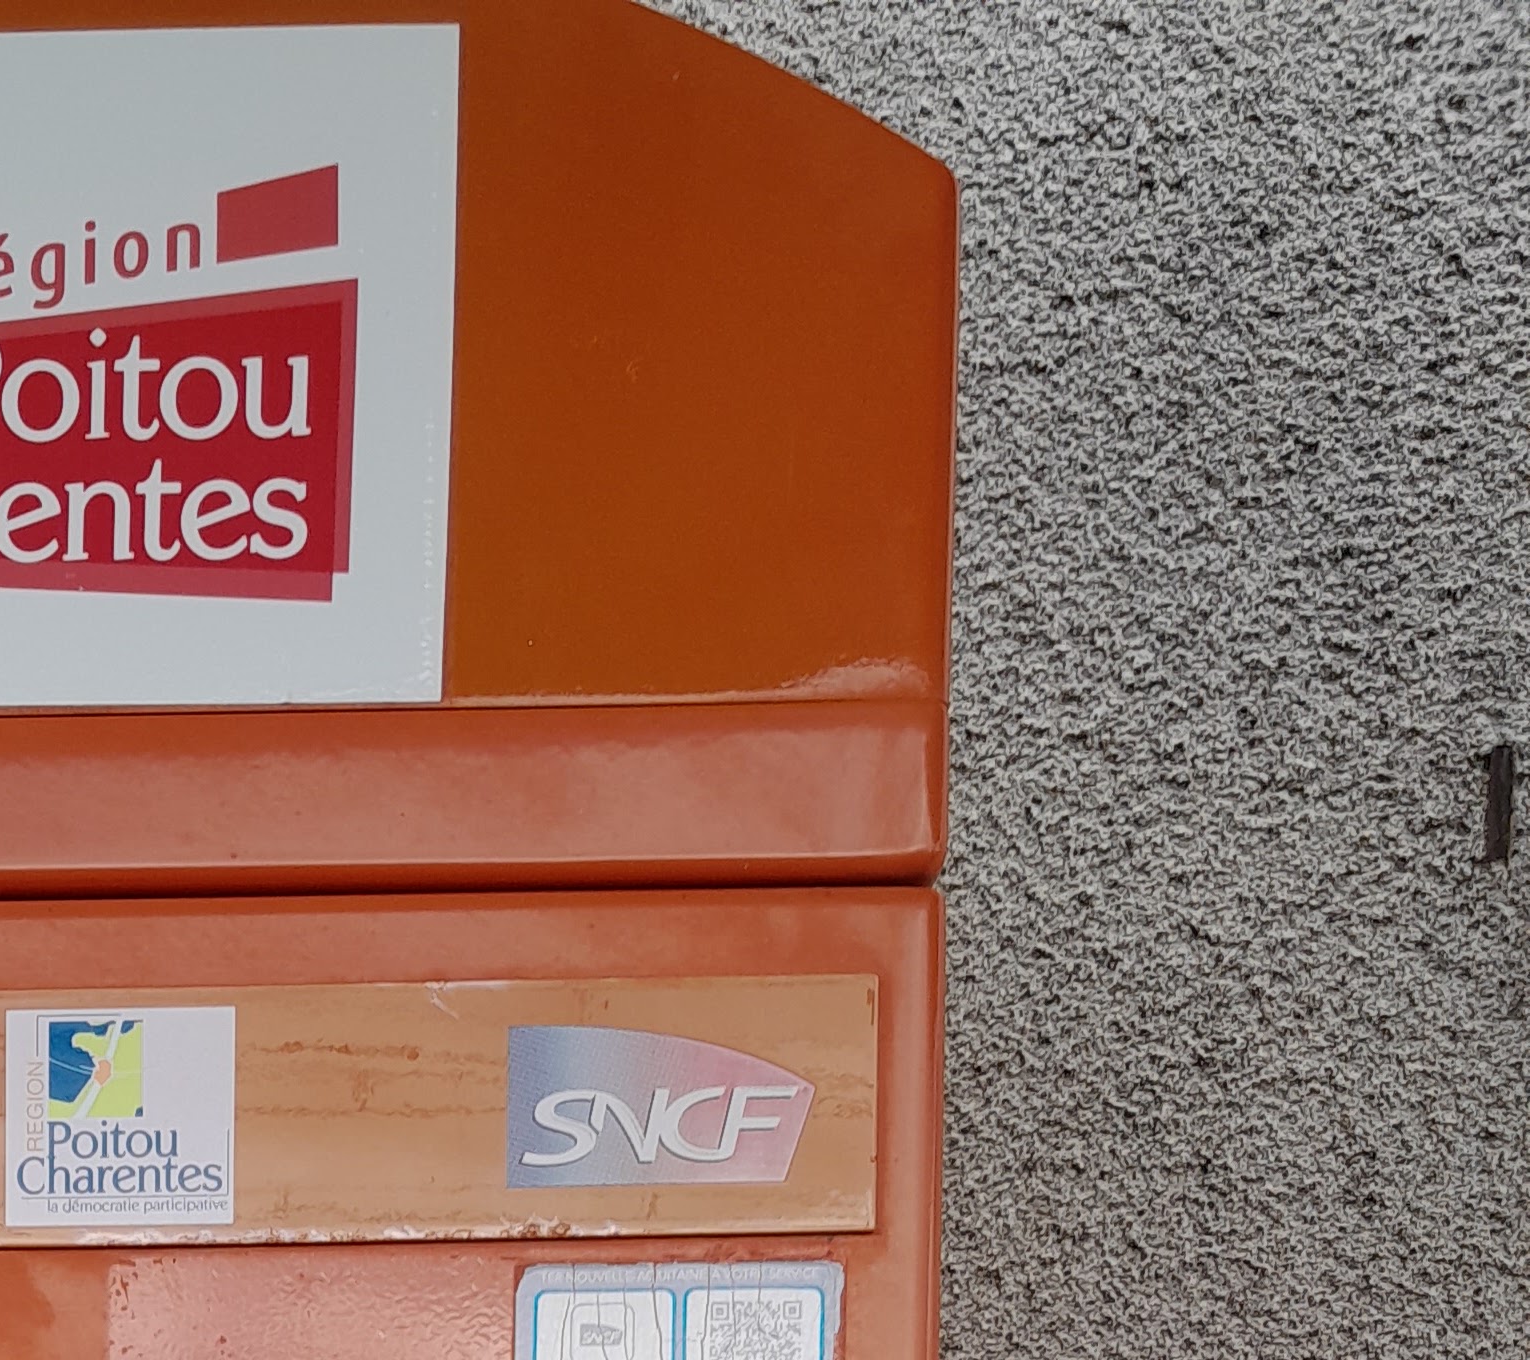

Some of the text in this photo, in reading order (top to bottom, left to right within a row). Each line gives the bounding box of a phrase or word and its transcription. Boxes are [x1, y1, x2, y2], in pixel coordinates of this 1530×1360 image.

[27, 1061, 45, 1152] REGION
[47, 1120, 178, 1159] Poitou
[519, 1085, 799, 1168] SNCF
[17, 1157, 223, 1195] Charentes
[47, 1198, 228, 1215] la démocratie participative
